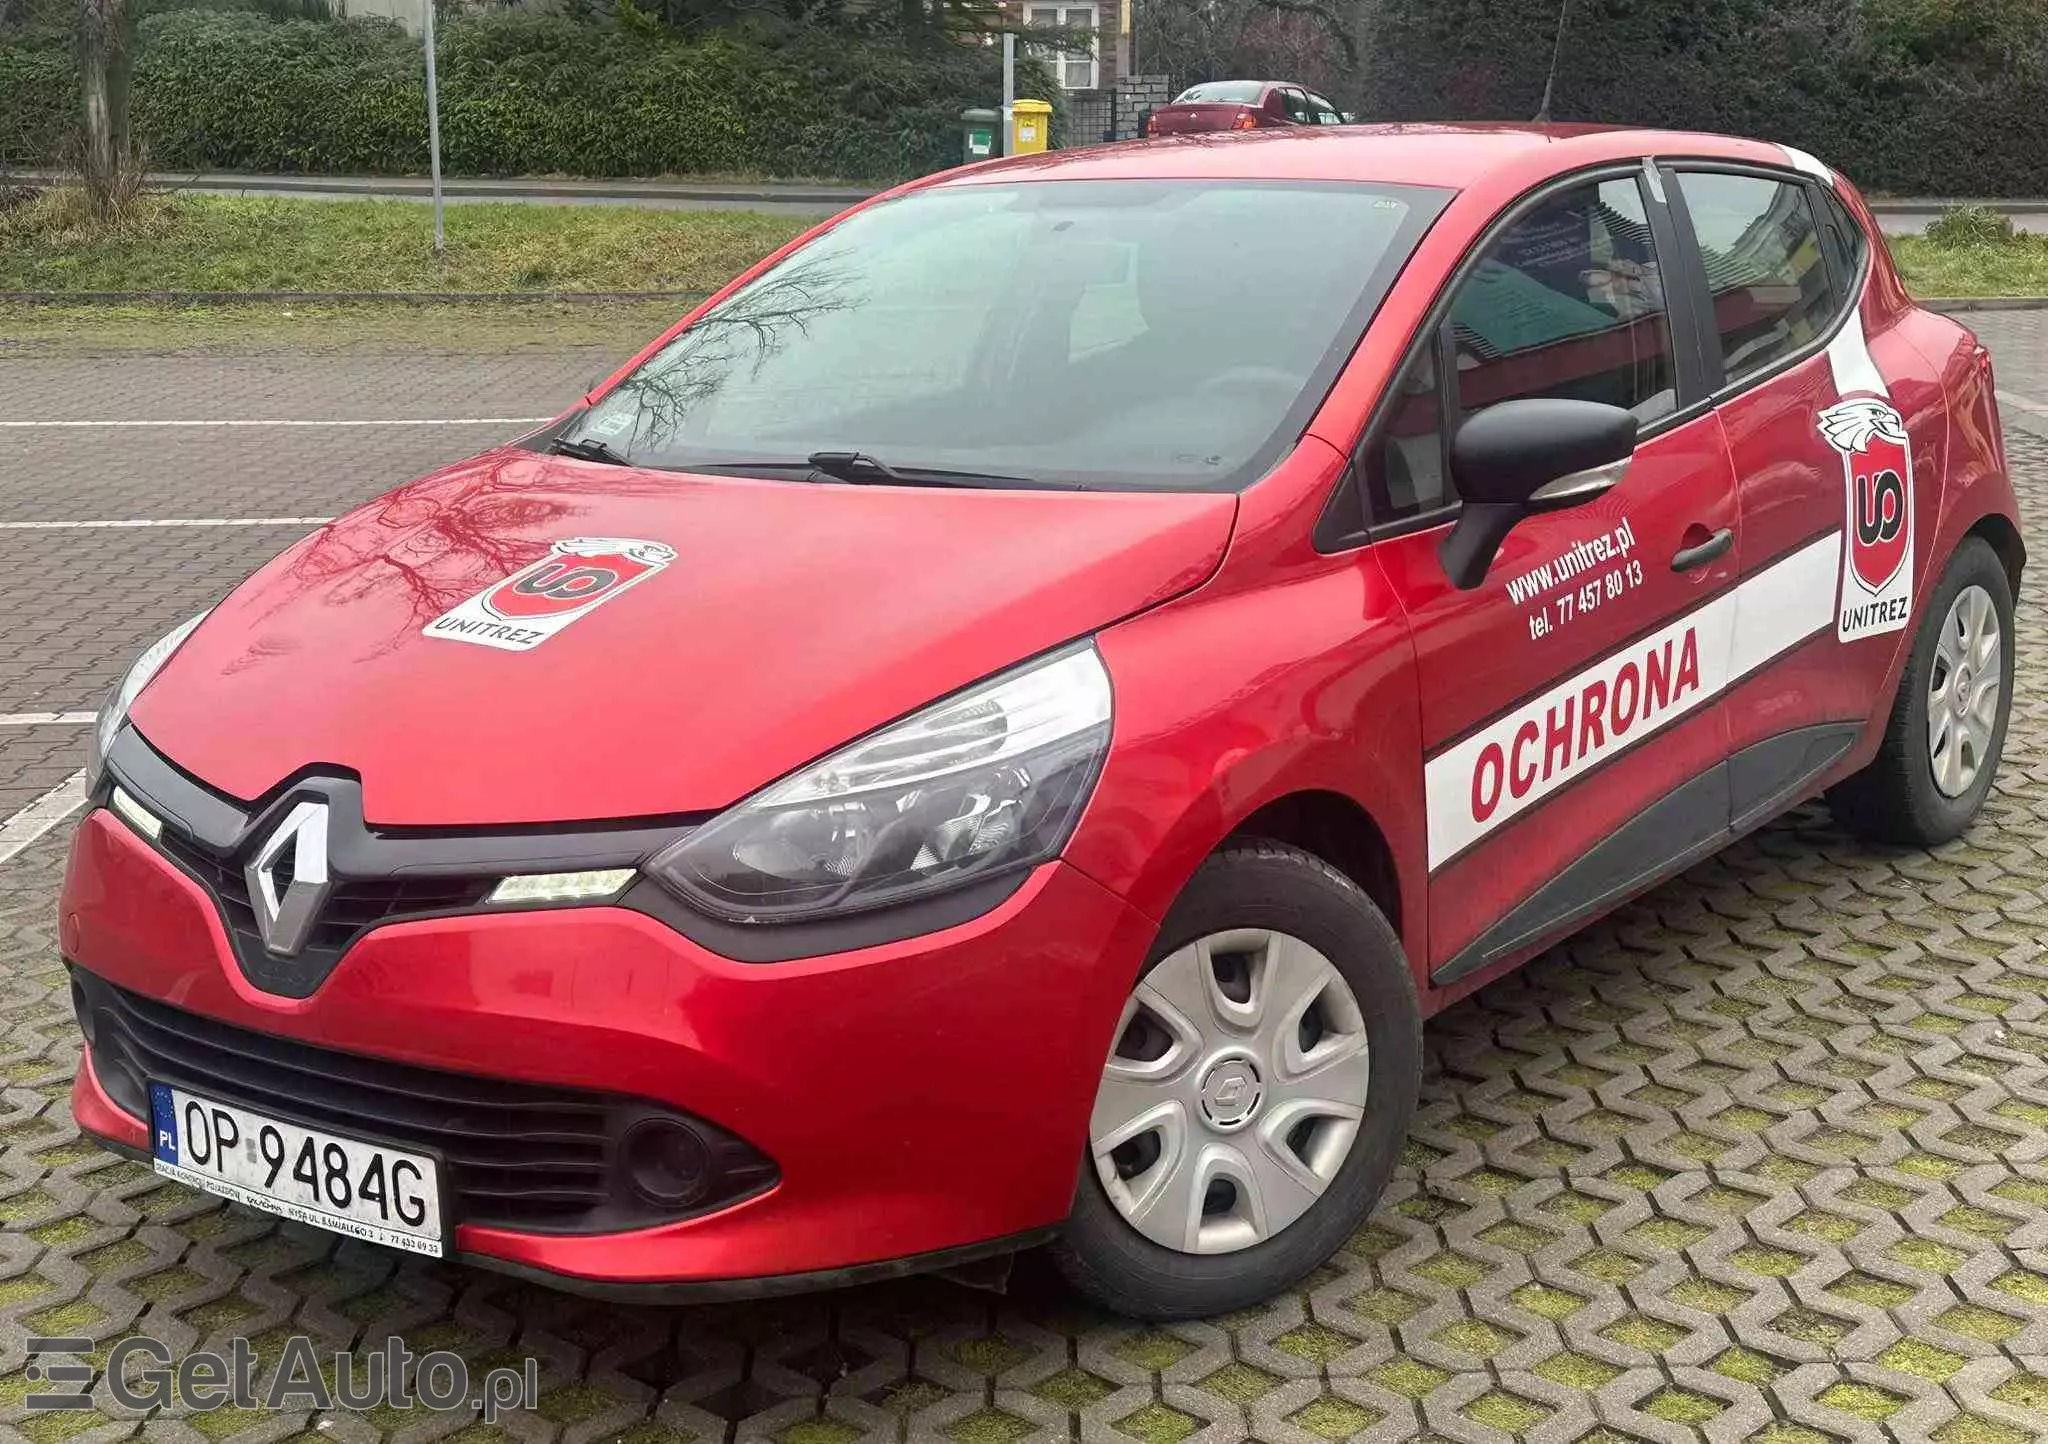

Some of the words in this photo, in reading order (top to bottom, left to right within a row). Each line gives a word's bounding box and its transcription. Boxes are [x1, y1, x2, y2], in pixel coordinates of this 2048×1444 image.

[1505, 517, 1636, 605] www.unitrez.pl
[1529, 607, 1553, 640] tel.
[1556, 593, 1574, 625] 77
[1578, 579, 1601, 613] 457
[1605, 569, 1623, 600] 80
[1625, 560, 1643, 588] 13
[433, 617, 546, 645] UNITREZ
[1842, 597, 1908, 633] UNITREZ
[1471, 627, 1700, 824] OCHRONA
[159, 1130, 176, 1151] PL
[185, 1101, 240, 1173] OP
[259, 1125, 426, 1226] 9484G
